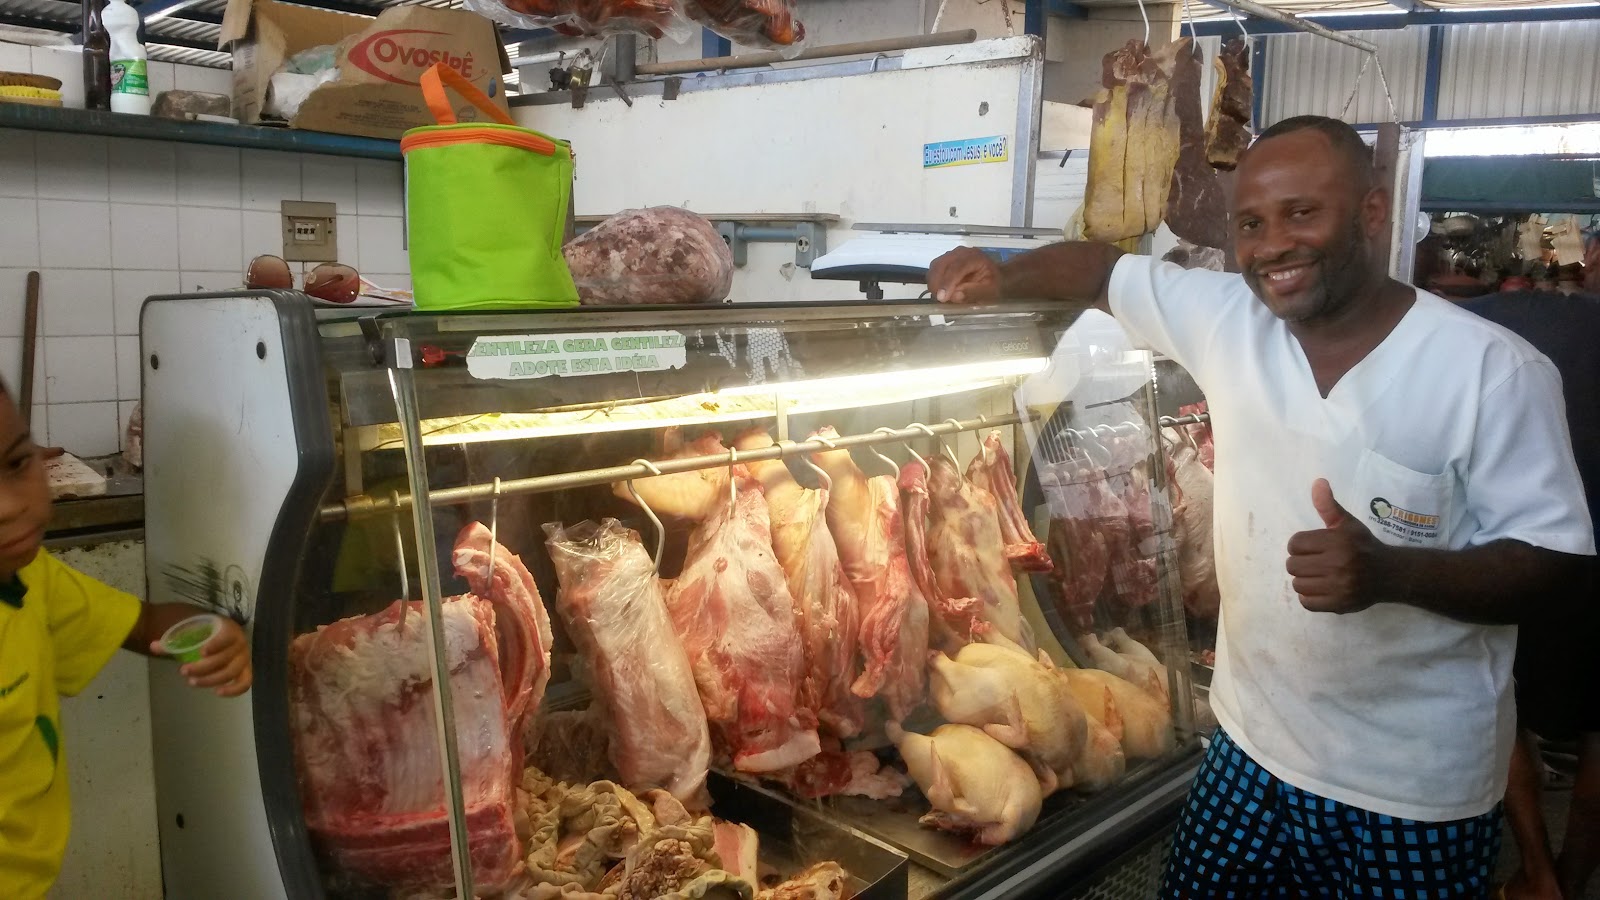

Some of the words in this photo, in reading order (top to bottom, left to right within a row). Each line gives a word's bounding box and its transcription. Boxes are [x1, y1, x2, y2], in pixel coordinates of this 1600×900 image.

[933, 145, 949, 163] estou
[950, 147, 962, 162] com
[983, 144, 987, 159] e
[989, 137, 1007, 158] você?
[468, 340, 560, 357] ENTILEZA
[563, 338, 608, 353] GERA
[509, 359, 568, 377] ADOTE
[571, 357, 612, 373] ESTA
[616, 353, 659, 370] IDÉIA
